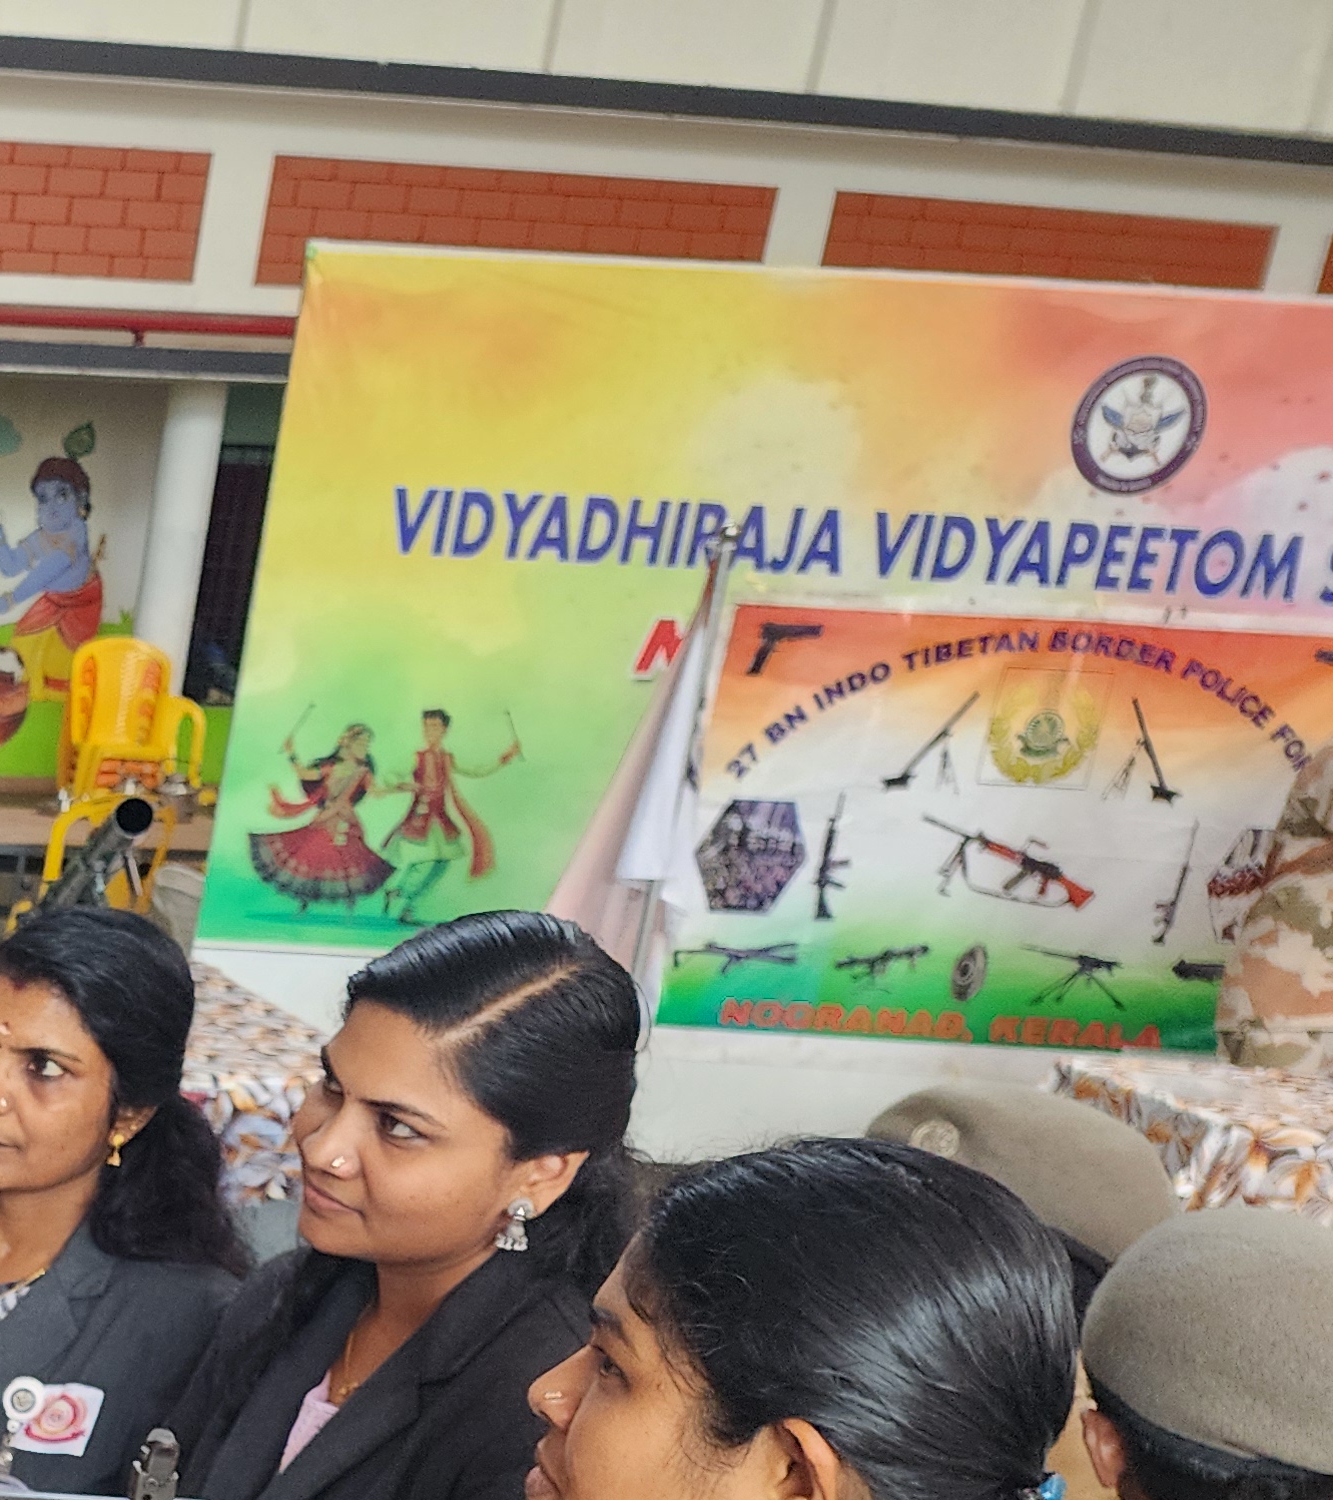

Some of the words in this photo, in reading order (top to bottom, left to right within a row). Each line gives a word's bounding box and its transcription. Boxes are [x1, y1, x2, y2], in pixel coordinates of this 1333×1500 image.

[393, 486, 842, 575] VIDYADHIRAJA
[874, 510, 1305, 601] VIDYAPEETOM
[726, 742, 758, 779] 27
[764, 704, 808, 745] BN
[812, 662, 892, 711] INDO
[901, 631, 1041, 673] TIBETAN
[1048, 629, 1177, 674] BORDER
[1181, 658, 1277, 730] POLICE
[717, 996, 973, 1043] NOORANAD,
[989, 1015, 1161, 1050] KERALA
